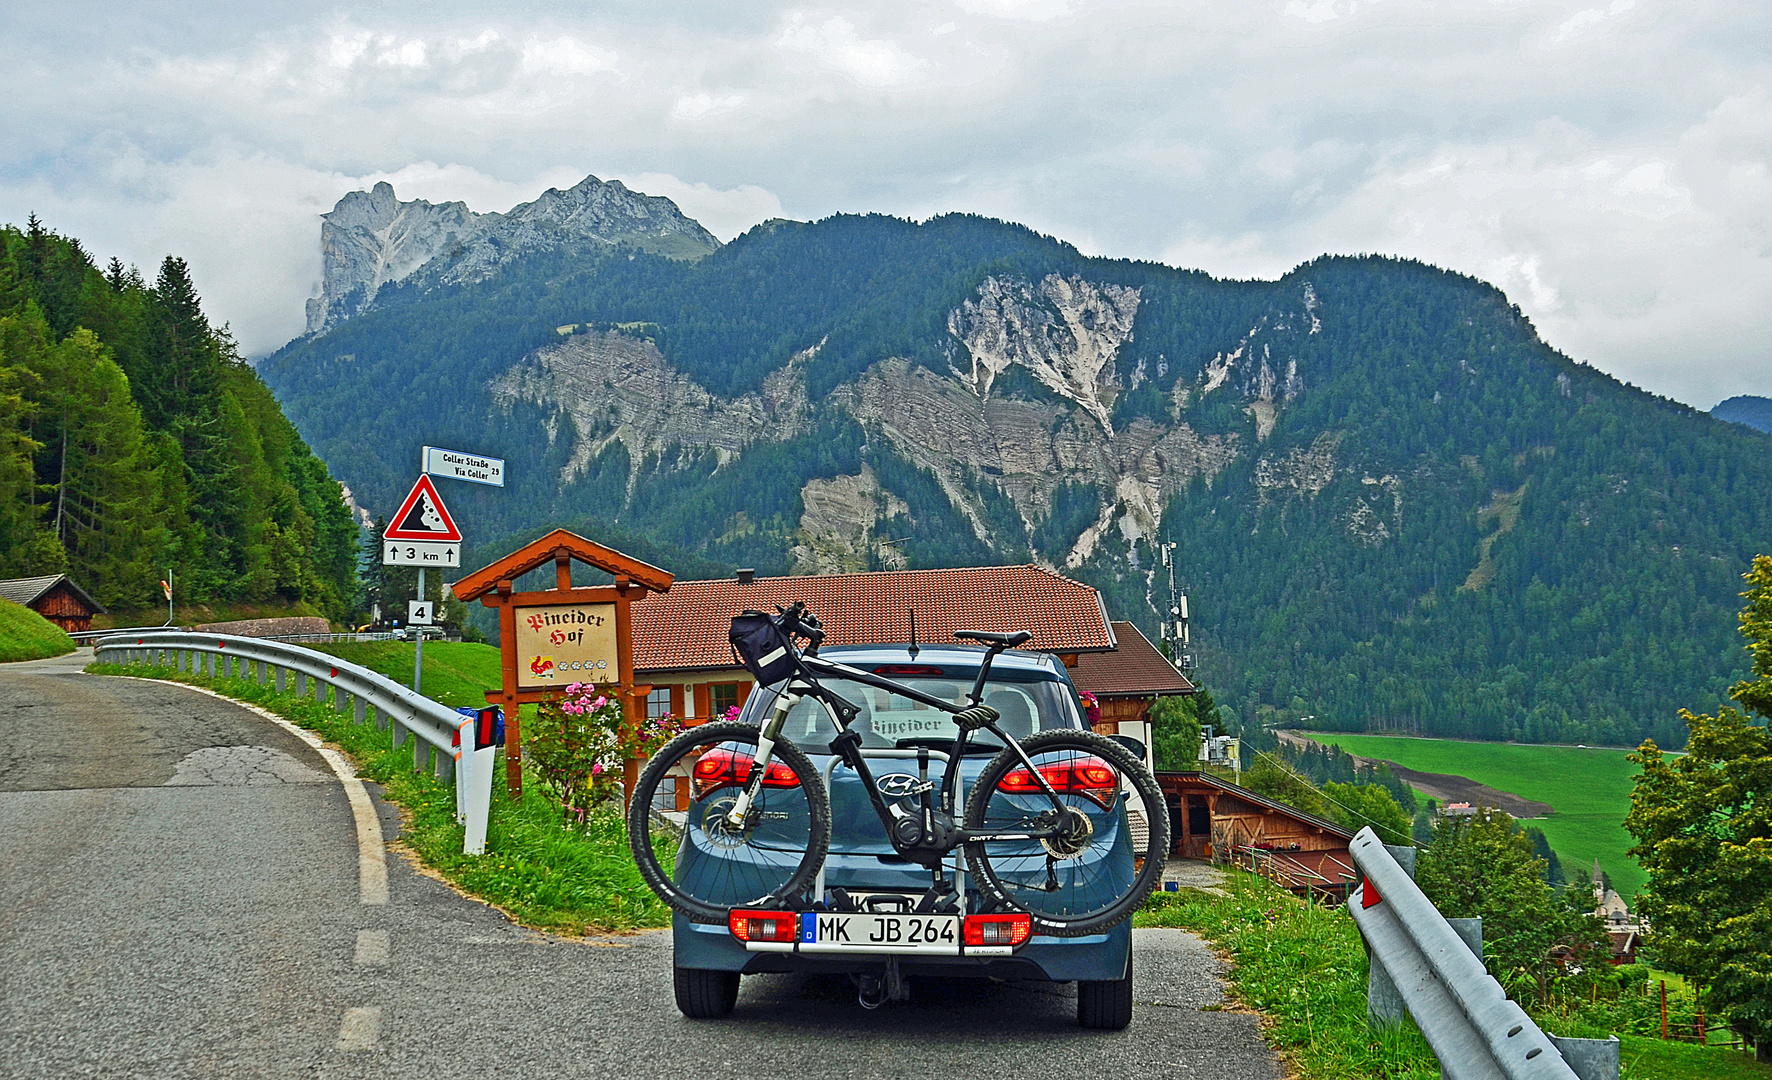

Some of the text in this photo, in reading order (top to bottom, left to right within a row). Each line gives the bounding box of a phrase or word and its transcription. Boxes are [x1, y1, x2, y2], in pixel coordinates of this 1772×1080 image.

[443, 453, 489, 469] Coller Straße
[454, 467, 489, 480] Via Coller
[491, 468, 500, 476] 29
[406, 547, 439, 561] 3 km
[414, 606, 426, 619] 4
[526, 609, 605, 634] Pineider
[549, 628, 584, 648] Hof
[806, 931, 813, 940] D
[819, 917, 954, 943] MK JB 264
